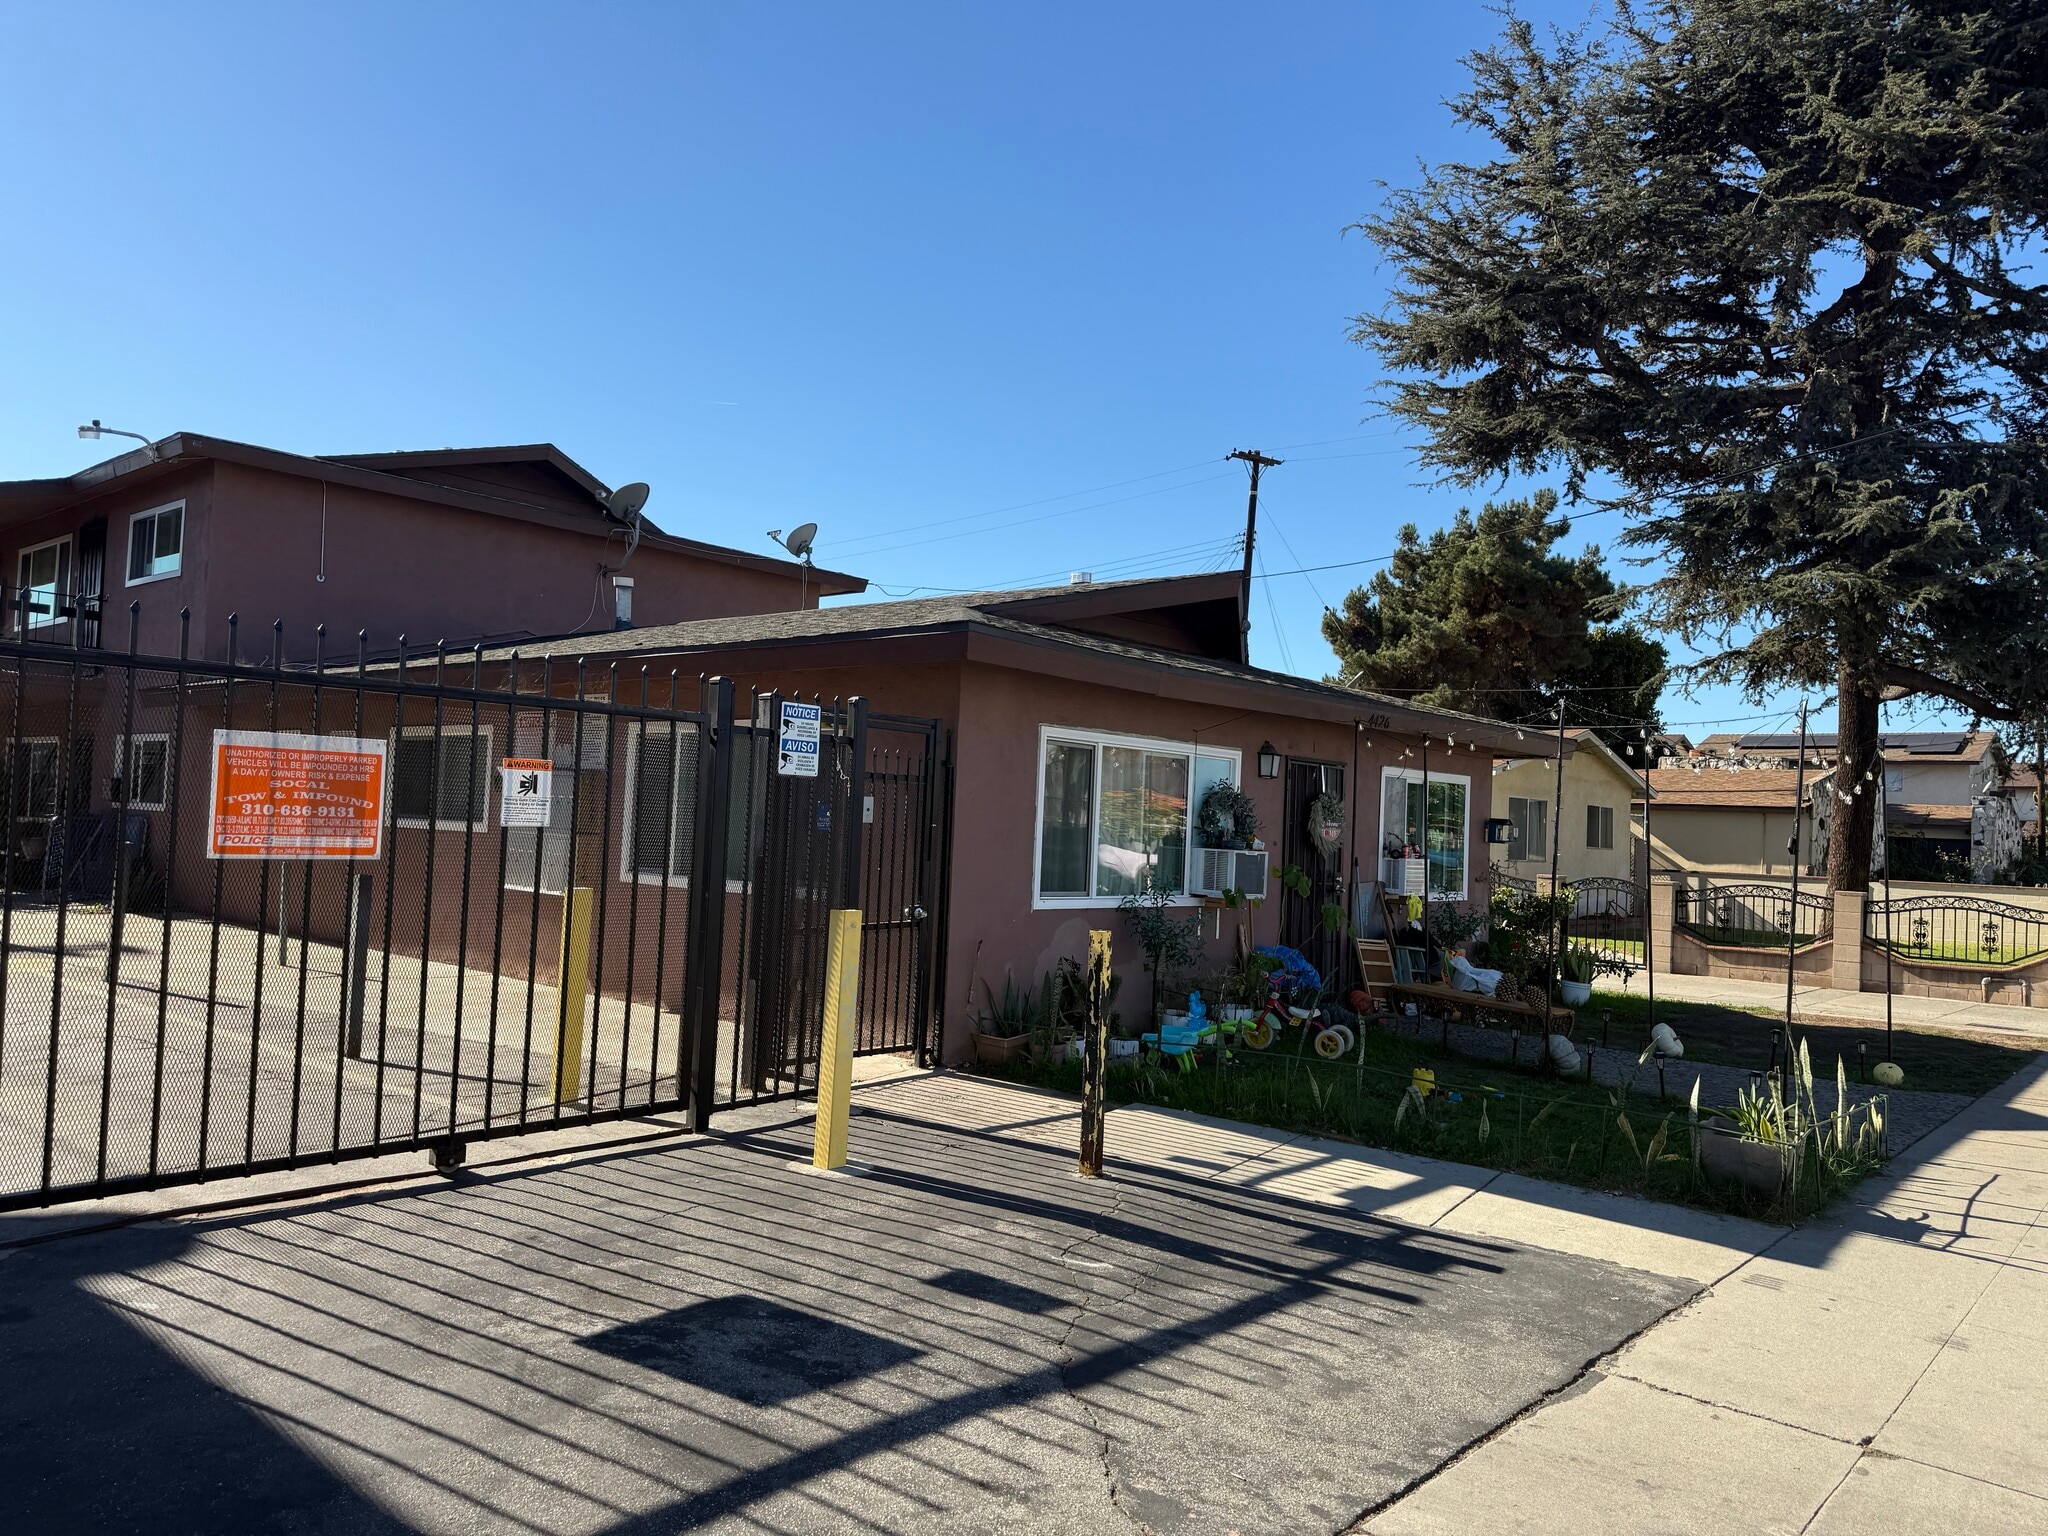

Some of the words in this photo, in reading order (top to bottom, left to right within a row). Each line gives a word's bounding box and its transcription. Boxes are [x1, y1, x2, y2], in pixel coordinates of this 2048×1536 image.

[785, 706, 817, 719] NOTICE
[1368, 713, 1391, 729] 4426
[785, 740, 814, 753] AVISO
[225, 749, 287, 760] UNAUTHORIZED
[301, 753, 348, 764] IMPROPERLY
[350, 756, 377, 765] PARKED
[226, 758, 268, 768] VEHICLES
[269, 760, 289, 769] WILL
[290, 761, 301, 769] BE
[303, 762, 348, 771] IMPOUNDED
[349, 764, 358, 772] 24
[359, 765, 377, 773] HRS.
[513, 761, 549, 770] WARNING
[232, 768, 241, 776] A
[241, 768, 258, 776] DAY
[258, 769, 269, 777] AT
[271, 770, 307, 778] OWNERS
[308, 771, 327, 779] RISK
[336, 773, 370, 782] EXPENSE
[270, 780, 330, 790] SOCAL
[224, 792, 267, 804] TOW
[273, 791, 287, 799] &
[293, 791, 374, 809] IMPOUND
[242, 804, 355, 818] 310-636-9131
[222, 835, 274, 845] POLICE:
